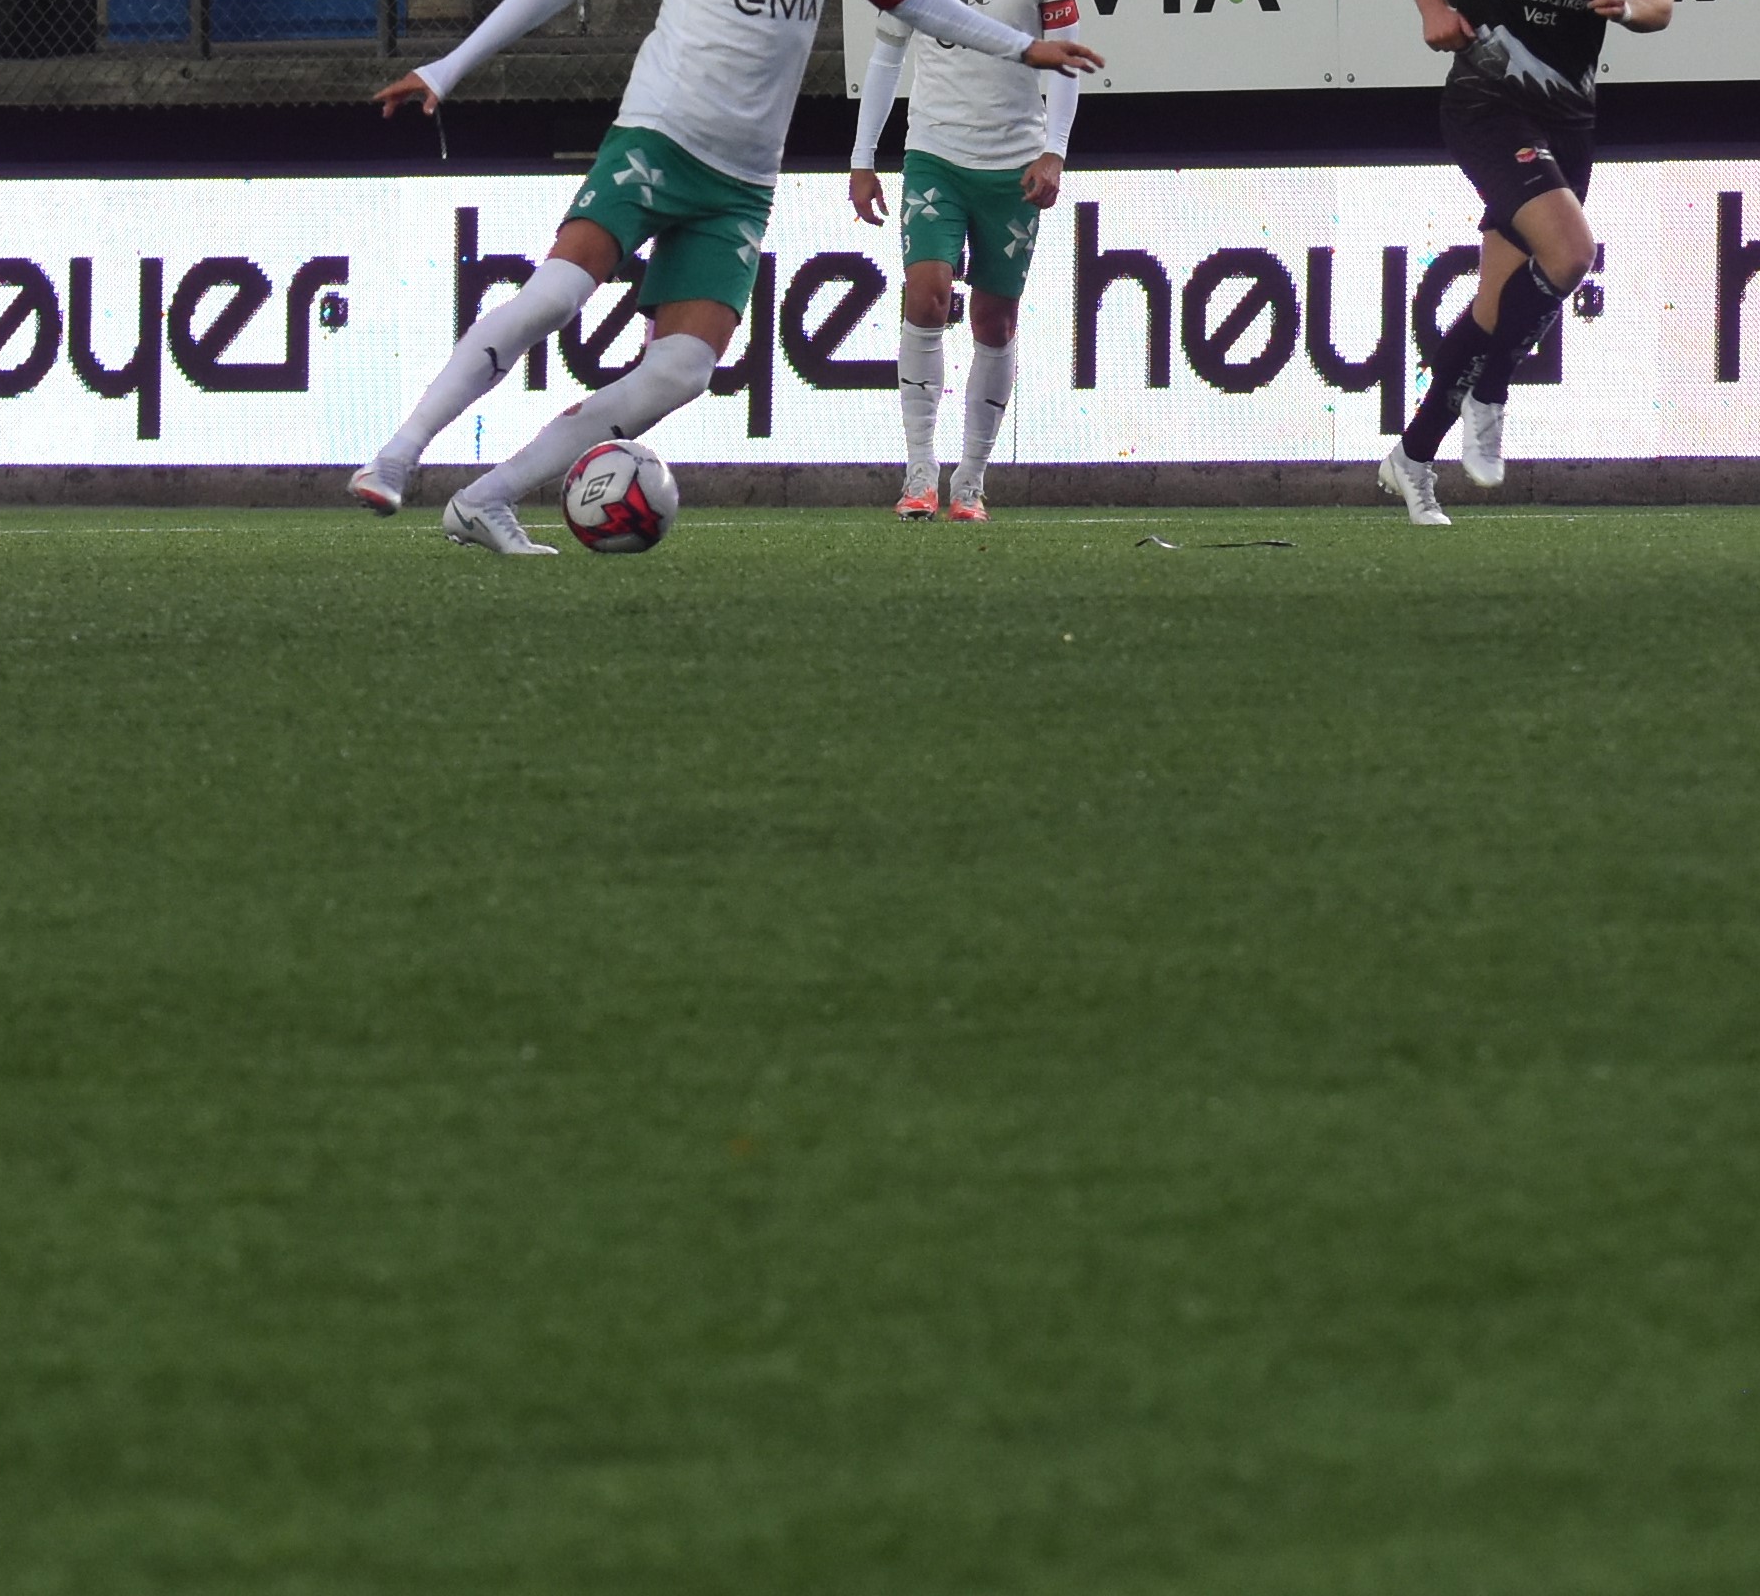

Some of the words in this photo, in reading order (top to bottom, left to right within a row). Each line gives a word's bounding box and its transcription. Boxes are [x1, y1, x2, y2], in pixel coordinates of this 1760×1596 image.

[1042, 5, 1073, 22] OPP
[1523, 5, 1559, 28] Vest
[578, 189, 597, 208] 8
